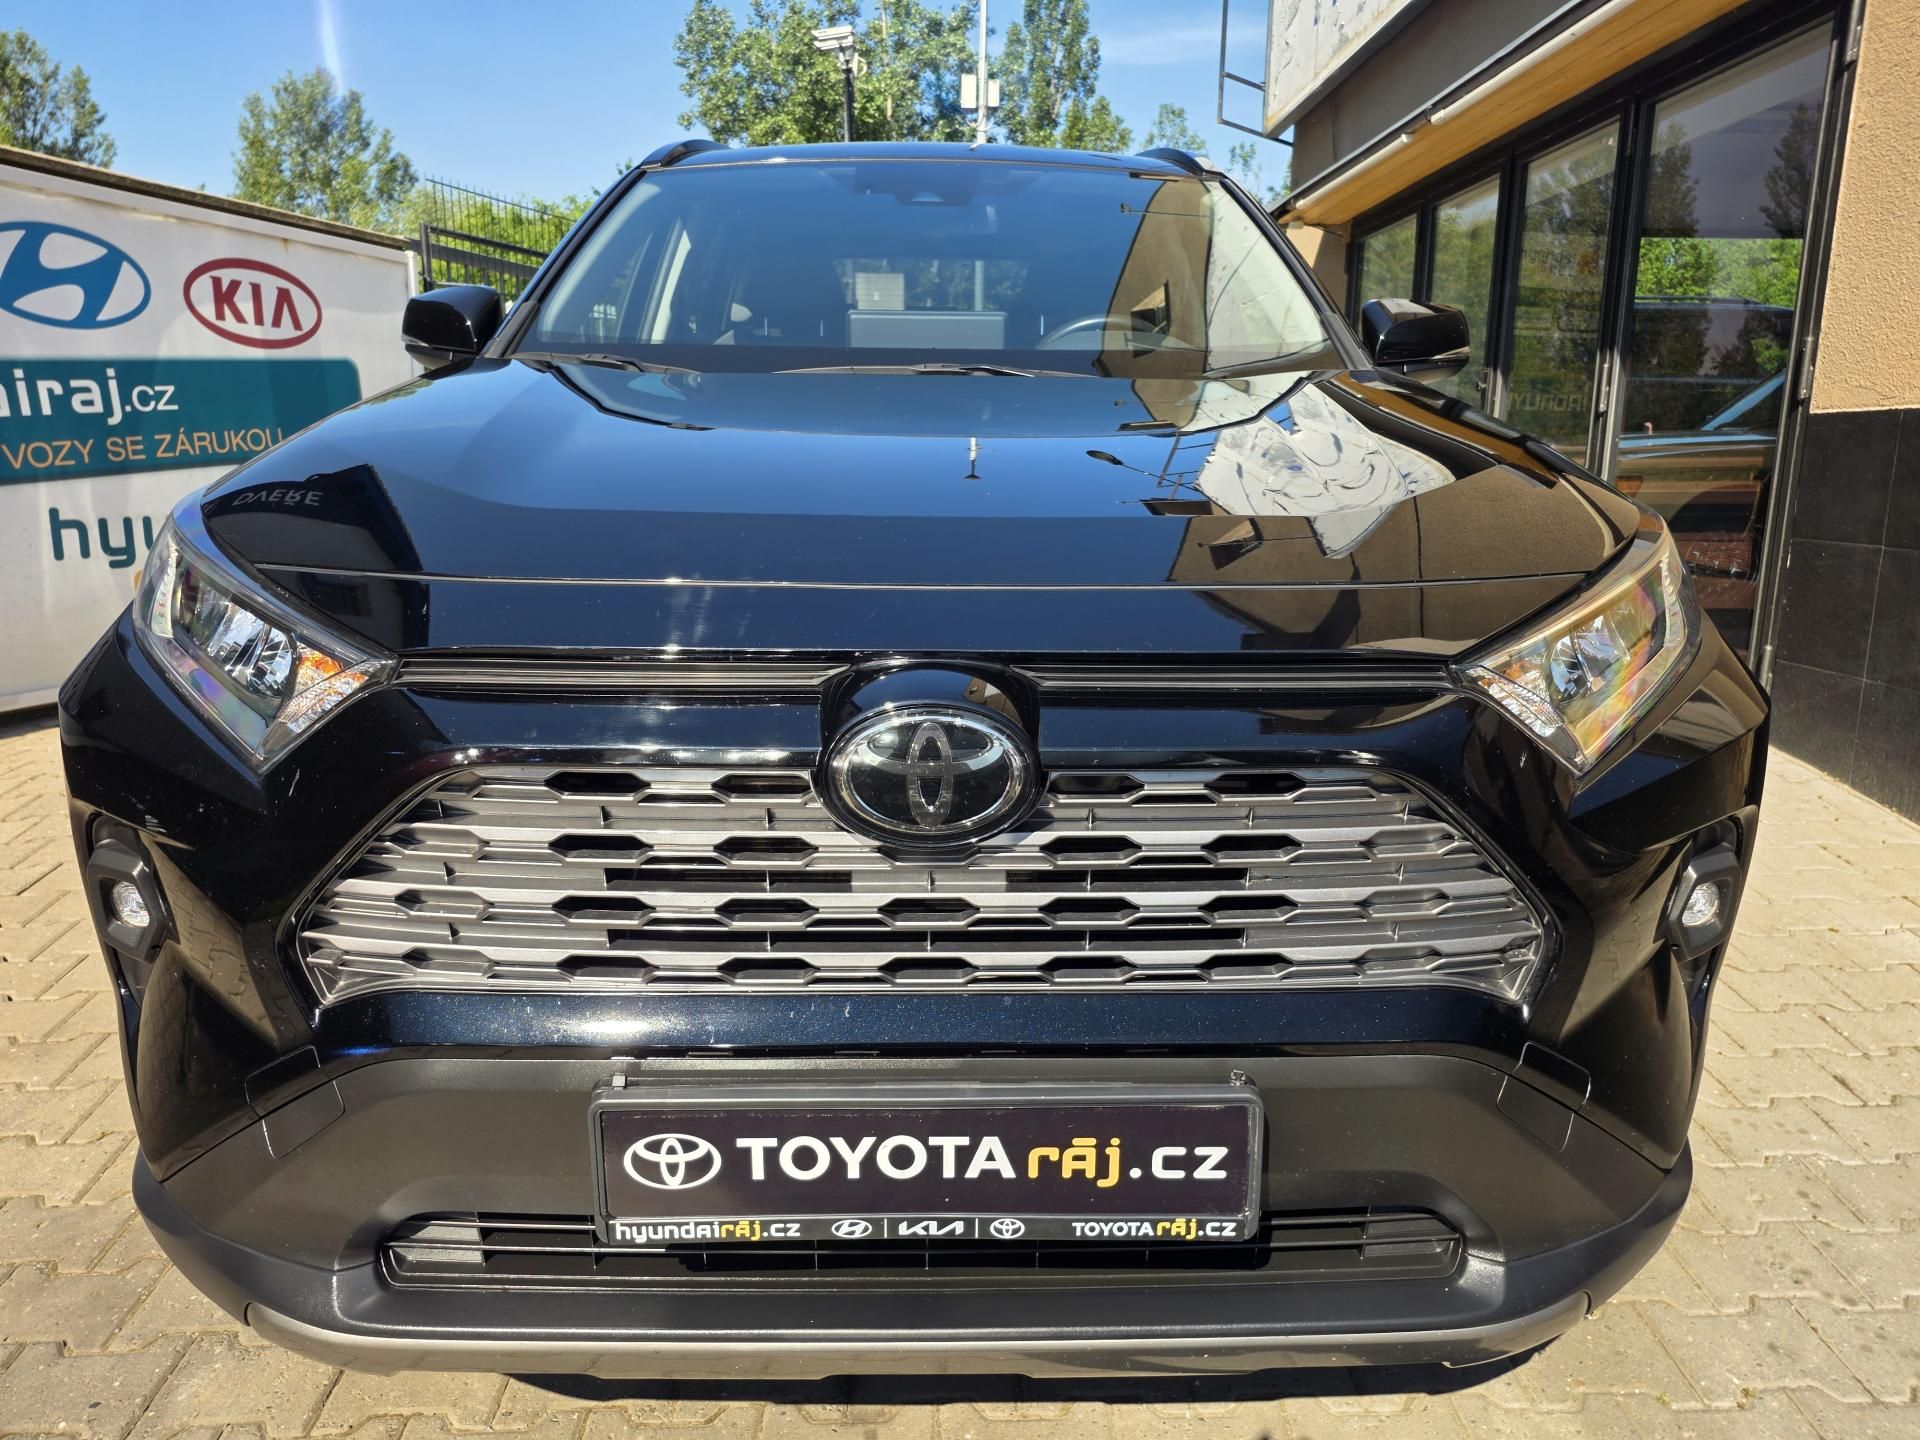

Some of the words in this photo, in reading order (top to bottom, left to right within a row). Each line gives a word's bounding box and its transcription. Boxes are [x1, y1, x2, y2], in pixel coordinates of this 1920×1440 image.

[209, 275, 303, 331] KIA
[1, 439, 94, 470] VOZY
[106, 436, 146, 462] SE
